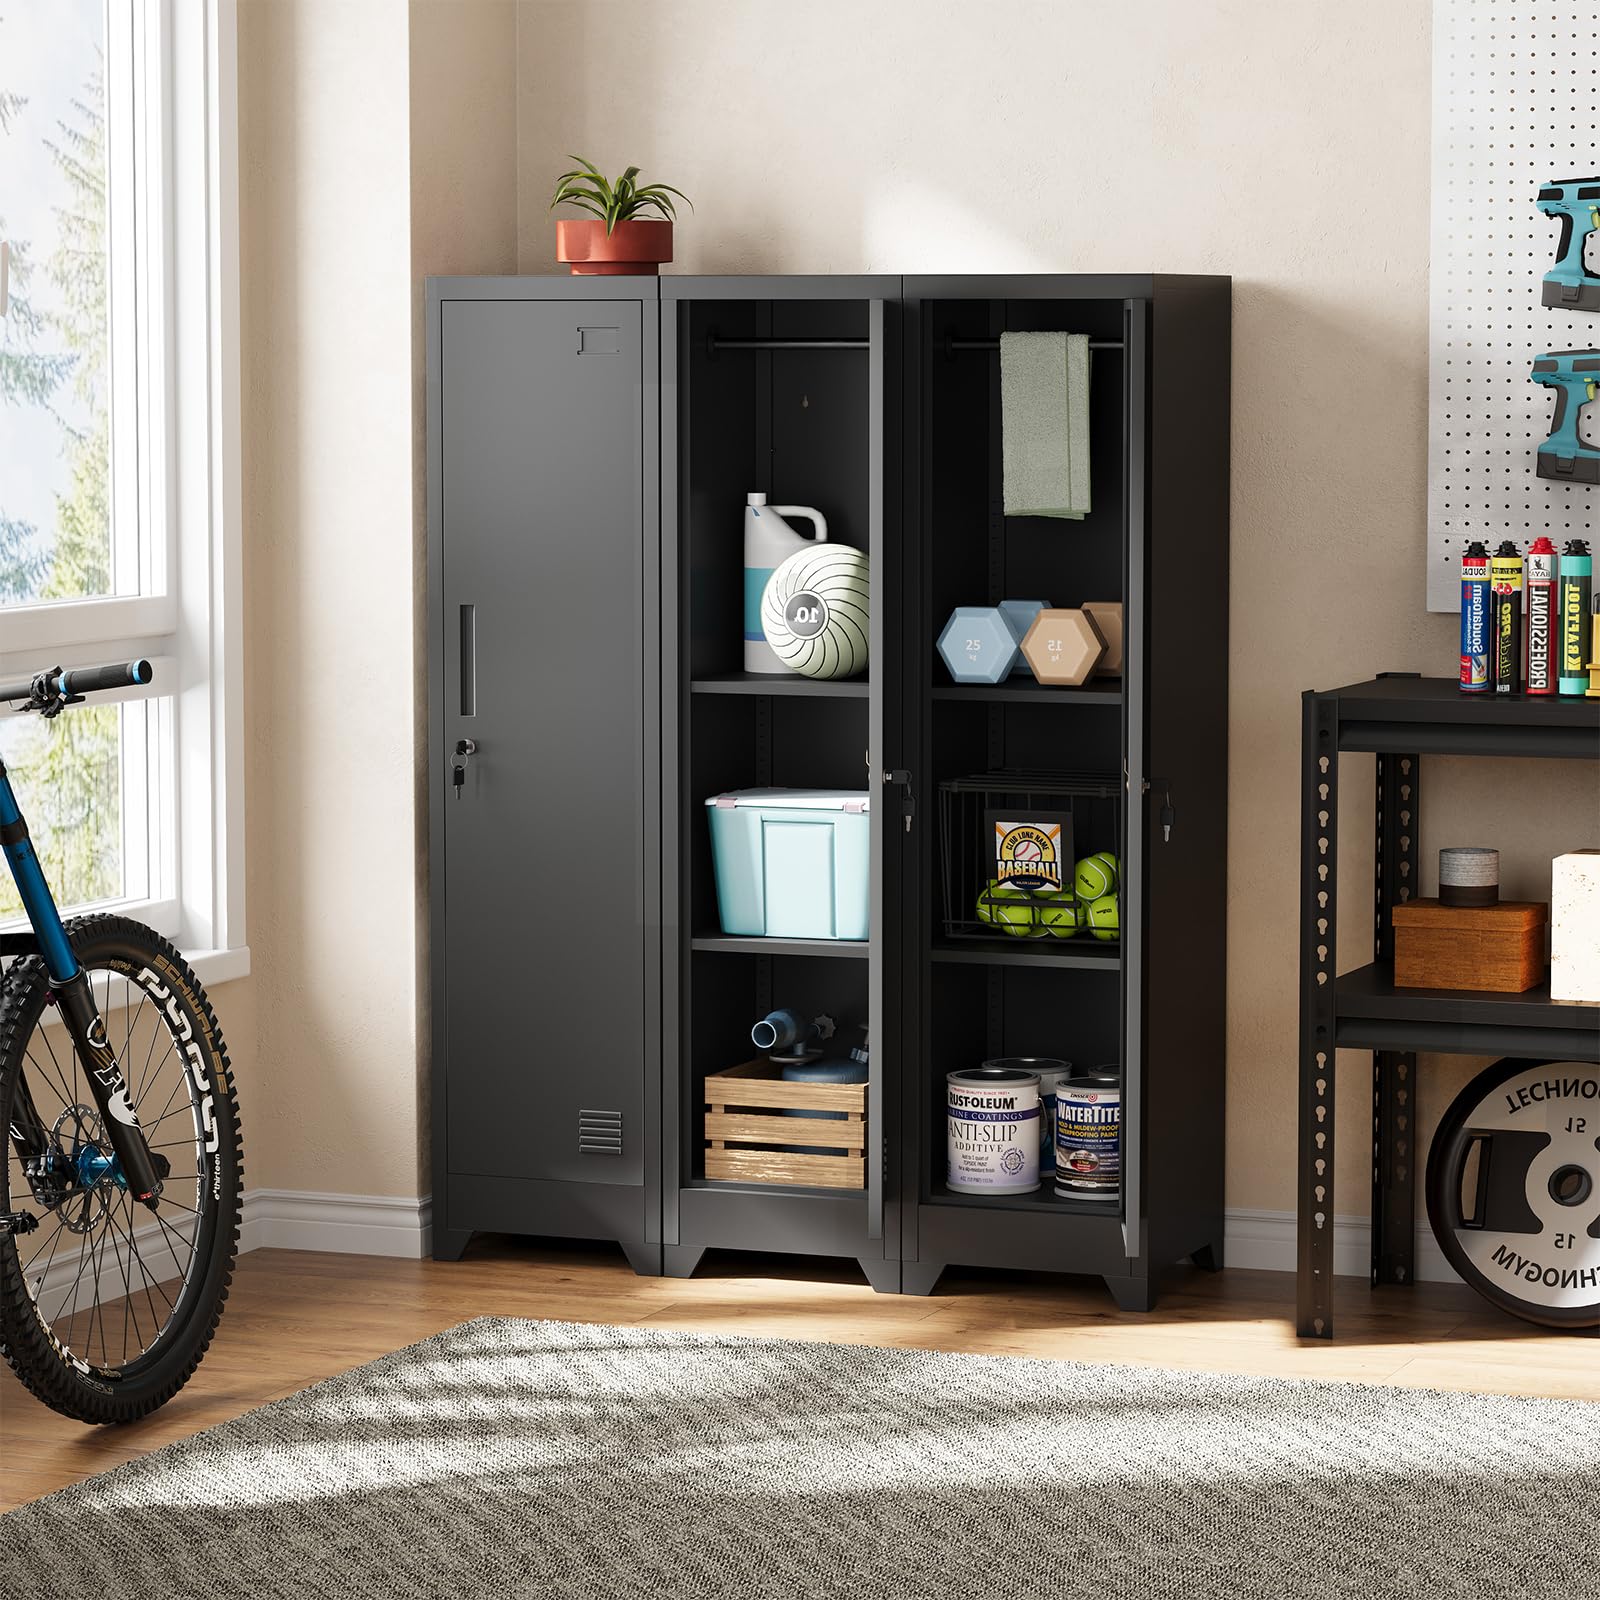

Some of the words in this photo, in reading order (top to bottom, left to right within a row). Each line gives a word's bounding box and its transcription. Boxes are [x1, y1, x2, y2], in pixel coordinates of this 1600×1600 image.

[965, 639, 981, 651] 25
[1005, 835, 1019, 851] CLUB
[1017, 831, 1034, 840] LONG
[1034, 834, 1050, 852] NAME
[997, 860, 1060, 884] BASEBALL
[152, 953, 229, 1096] SCHWALBE
[949, 1091, 1015, 1110] RUST-OLEUM
[971, 1111, 1023, 1121] COATINGS
[948, 1120, 1018, 1142] ANTI-SLIP
[954, 1141, 1004, 1153] ADDITIVE
